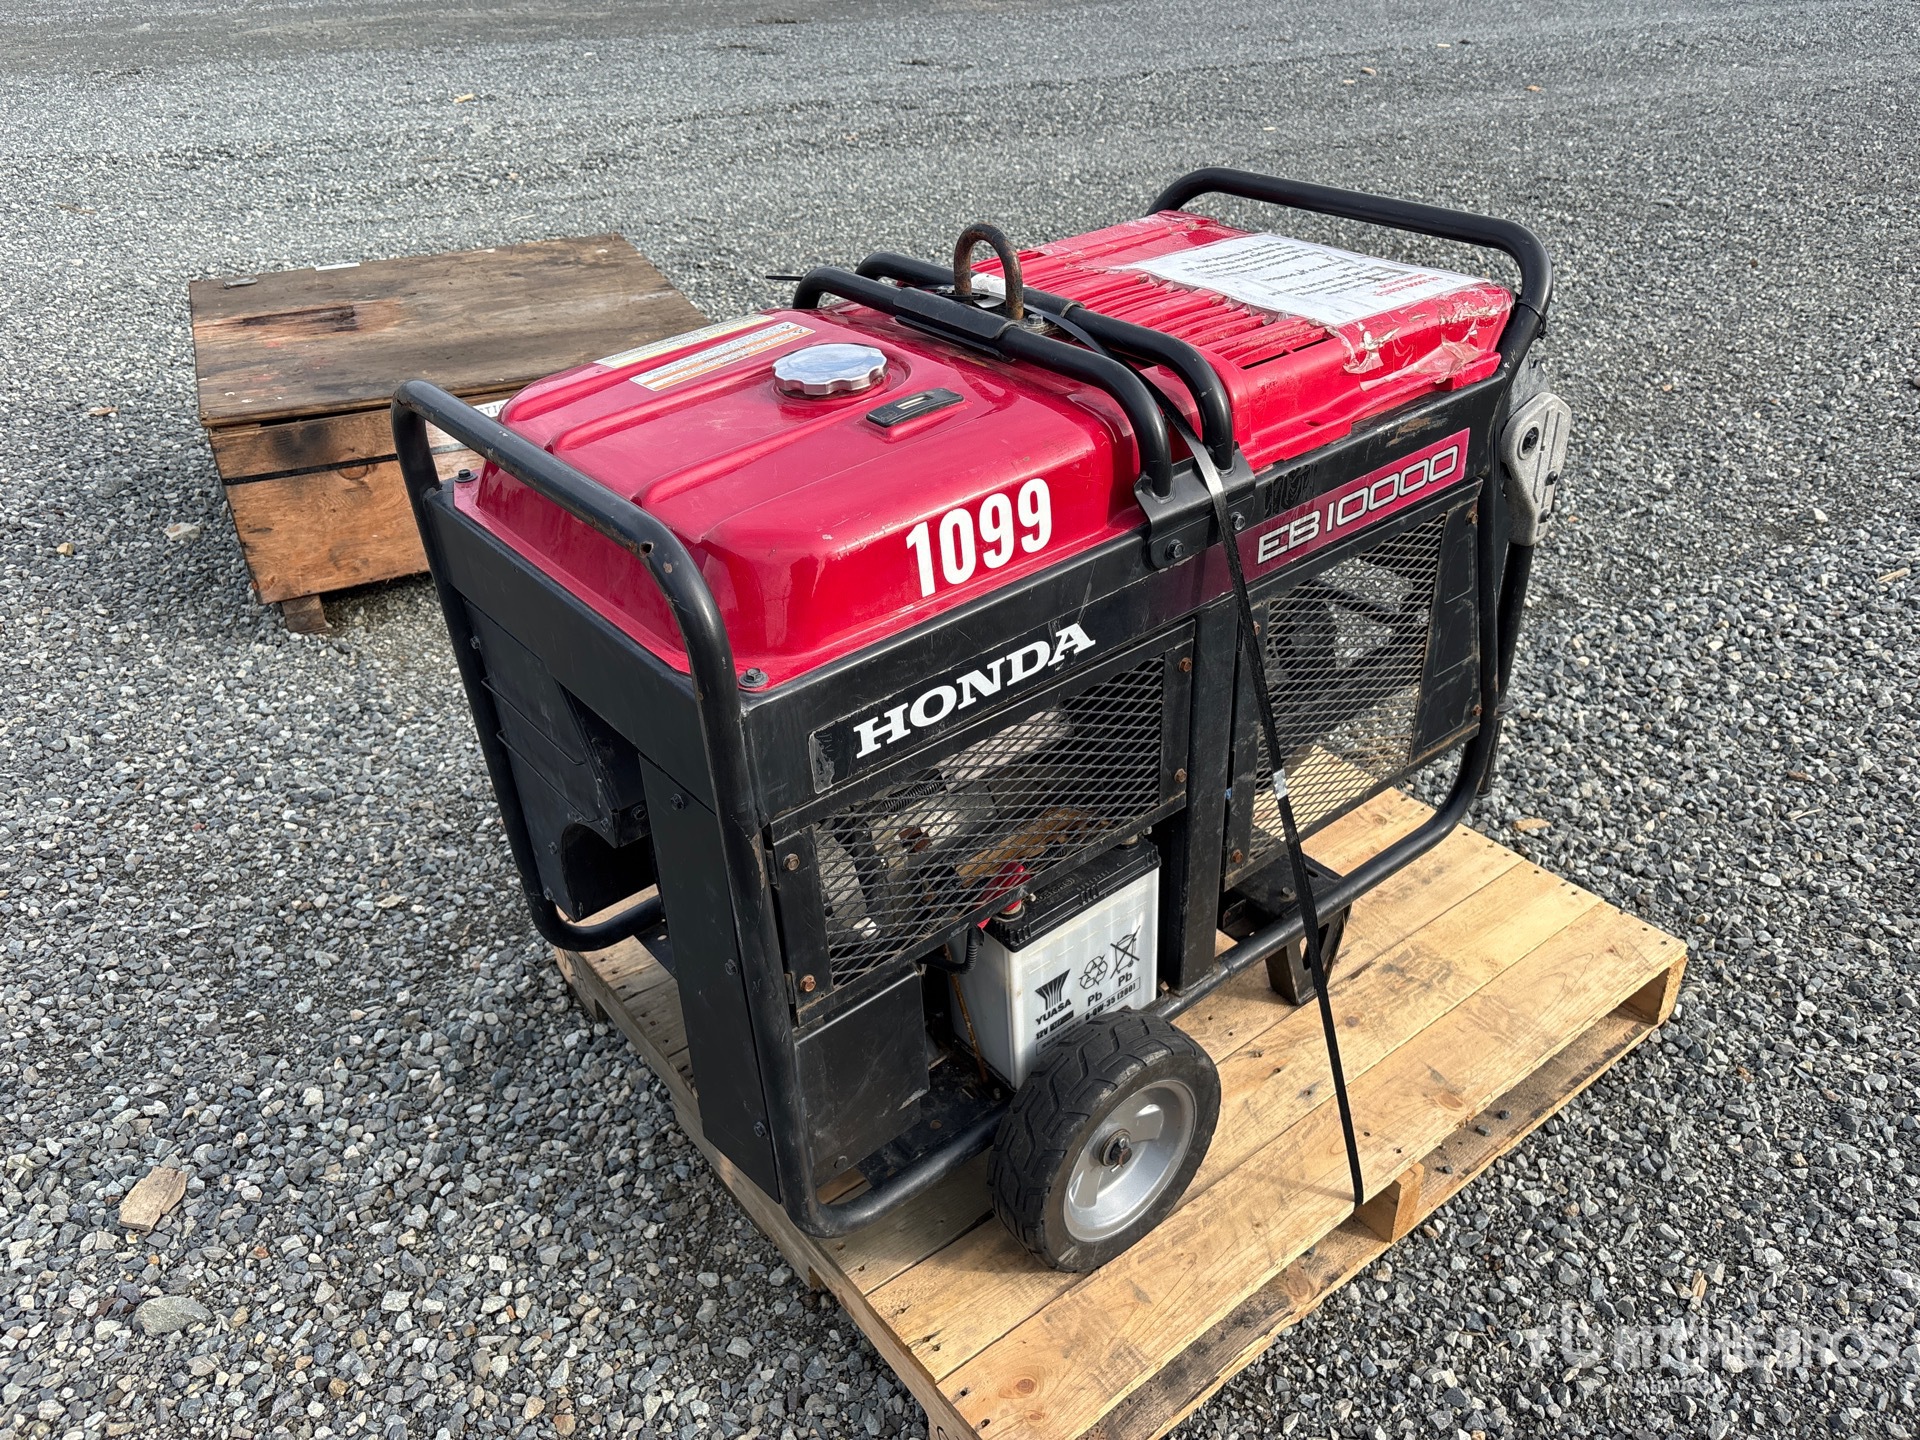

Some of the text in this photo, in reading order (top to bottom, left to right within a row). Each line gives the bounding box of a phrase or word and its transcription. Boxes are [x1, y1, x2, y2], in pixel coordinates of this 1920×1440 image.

[906, 478, 1052, 598] 1099
[853, 623, 1096, 759] HONDA
[1118, 972, 1133, 987] Pb
[1087, 991, 1103, 1007] Pb
[1035, 998, 1072, 1025] YUASA
[1036, 1027, 1049, 1040] 12V
